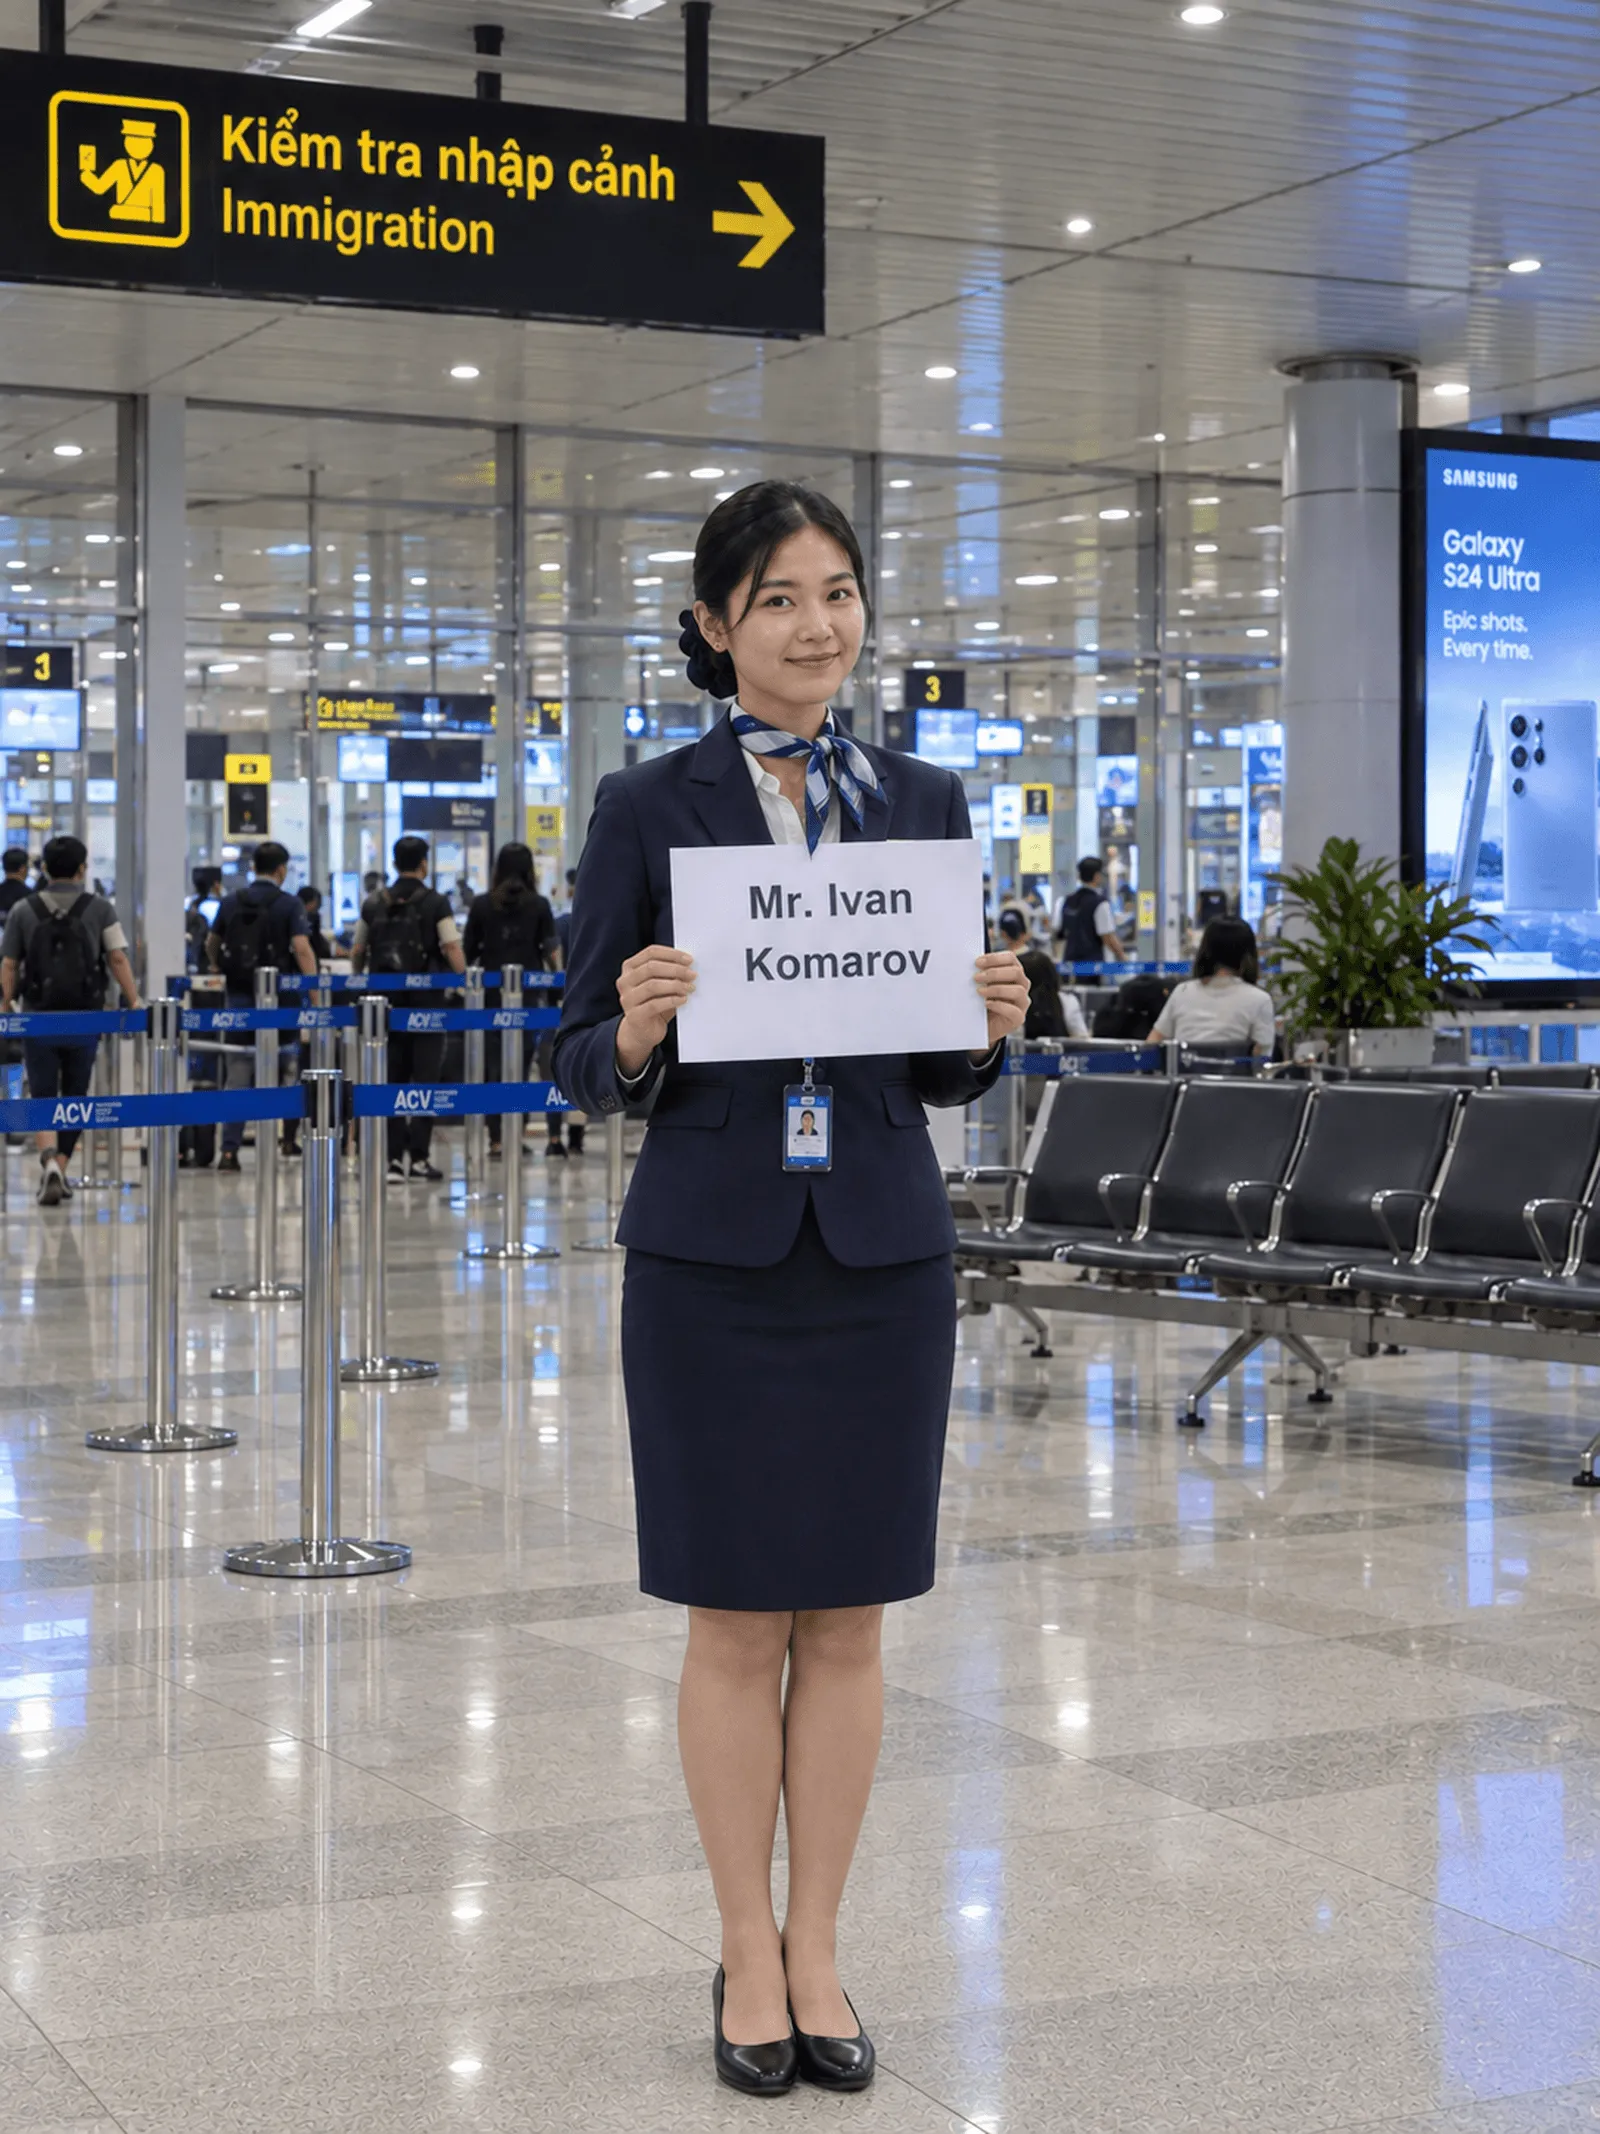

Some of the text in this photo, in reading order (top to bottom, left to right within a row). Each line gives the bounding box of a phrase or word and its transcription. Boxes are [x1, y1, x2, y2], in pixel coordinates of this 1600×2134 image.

[222, 107, 675, 201] Kiểm tra nhập cảnh
[222, 187, 495, 256] Immigration
[1443, 468, 1518, 490] SAMSUNG
[1443, 529, 1525, 565] Galaxy
[1443, 562, 1541, 592] S24 Ultra
[1443, 609, 1528, 635] Epic shots.
[1443, 637, 1533, 664] Every time.
[925, 675, 941, 703] 3
[749, 883, 912, 919] Mr. Ivan
[745, 947, 931, 981] Komarov
[52, 1102, 94, 1124] ACV
[394, 1090, 432, 1109] ACV
